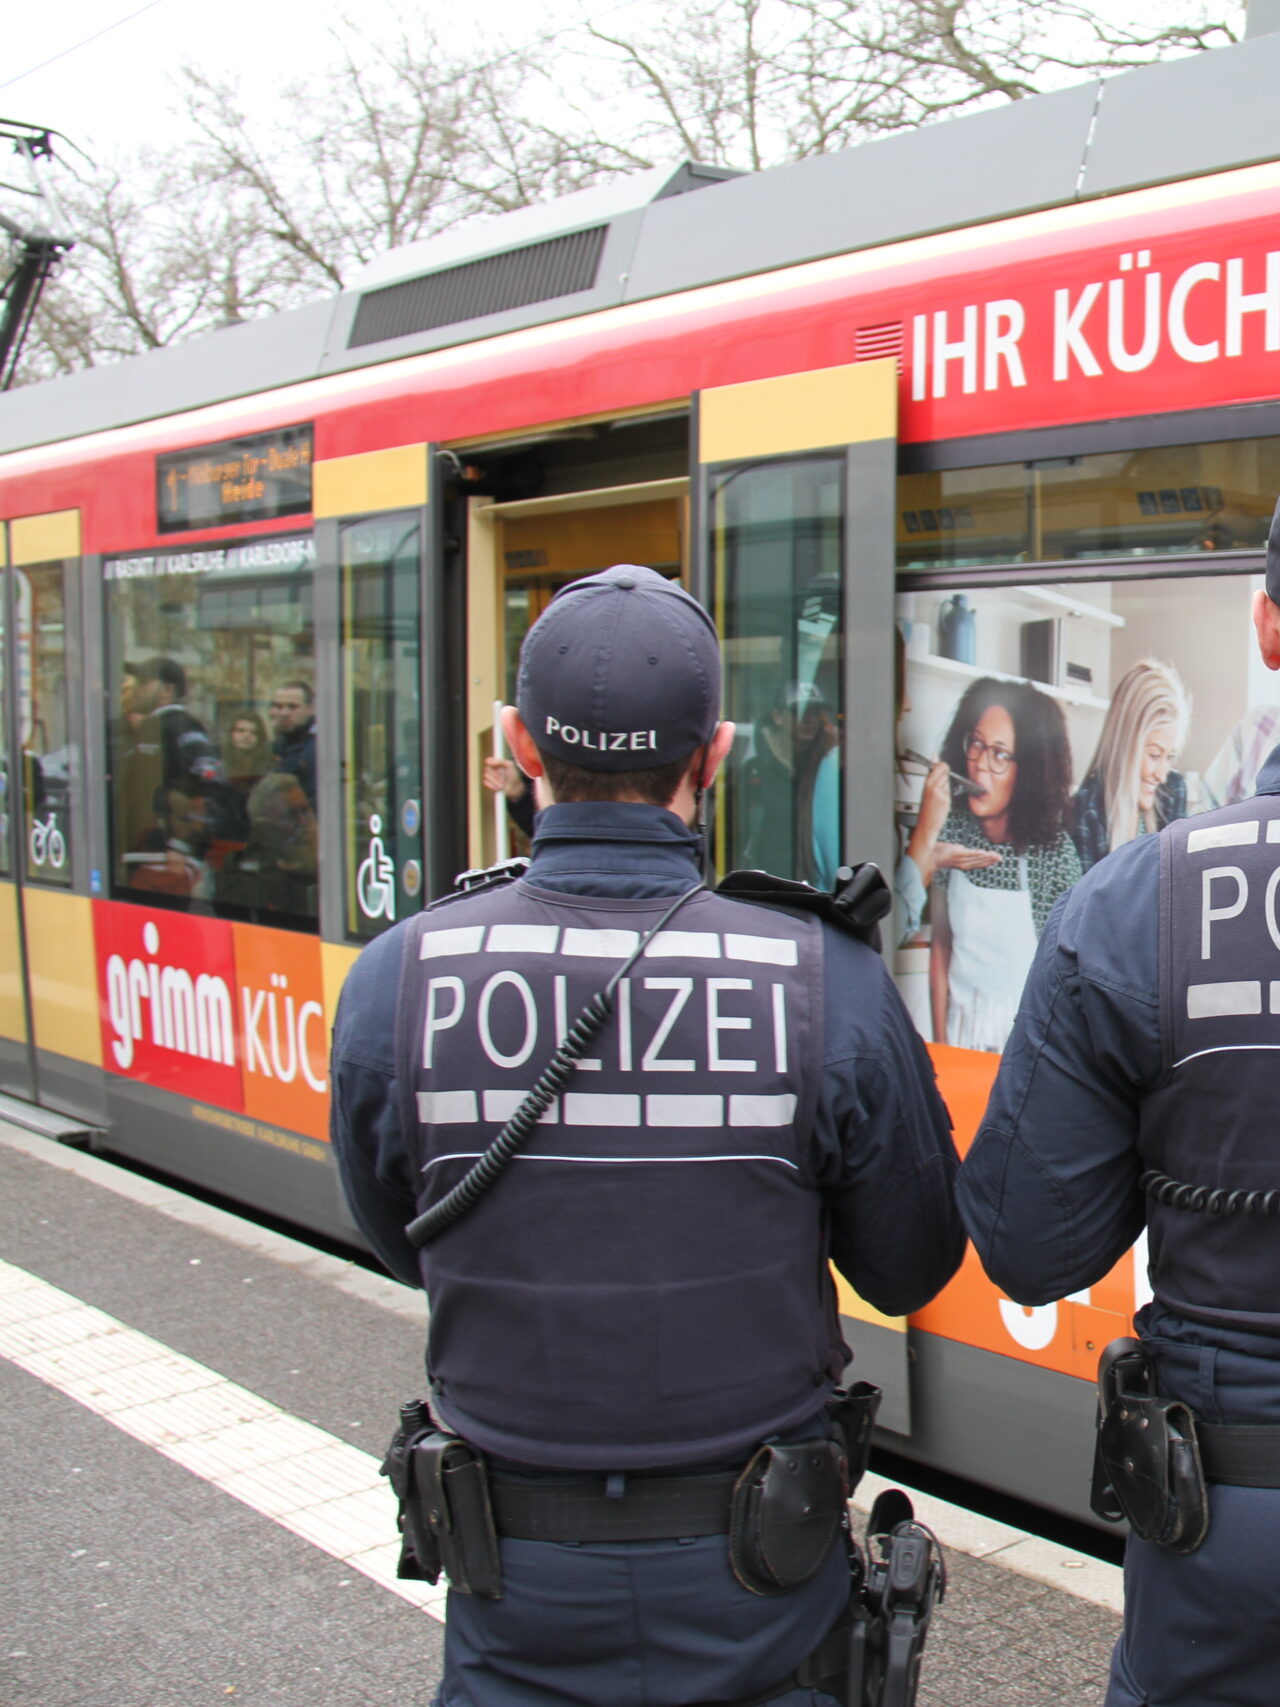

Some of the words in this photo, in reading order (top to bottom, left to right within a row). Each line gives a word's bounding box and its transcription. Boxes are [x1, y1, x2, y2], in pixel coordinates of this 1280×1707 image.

[911, 298, 1027, 402] IHR
[114, 556, 155, 579] RASTATT
[167, 549, 226, 575] KARLSRUHE
[545, 715, 657, 751] POLIZEI
[107, 921, 236, 1069] grimm
[422, 970, 788, 1074] POLIZEI
